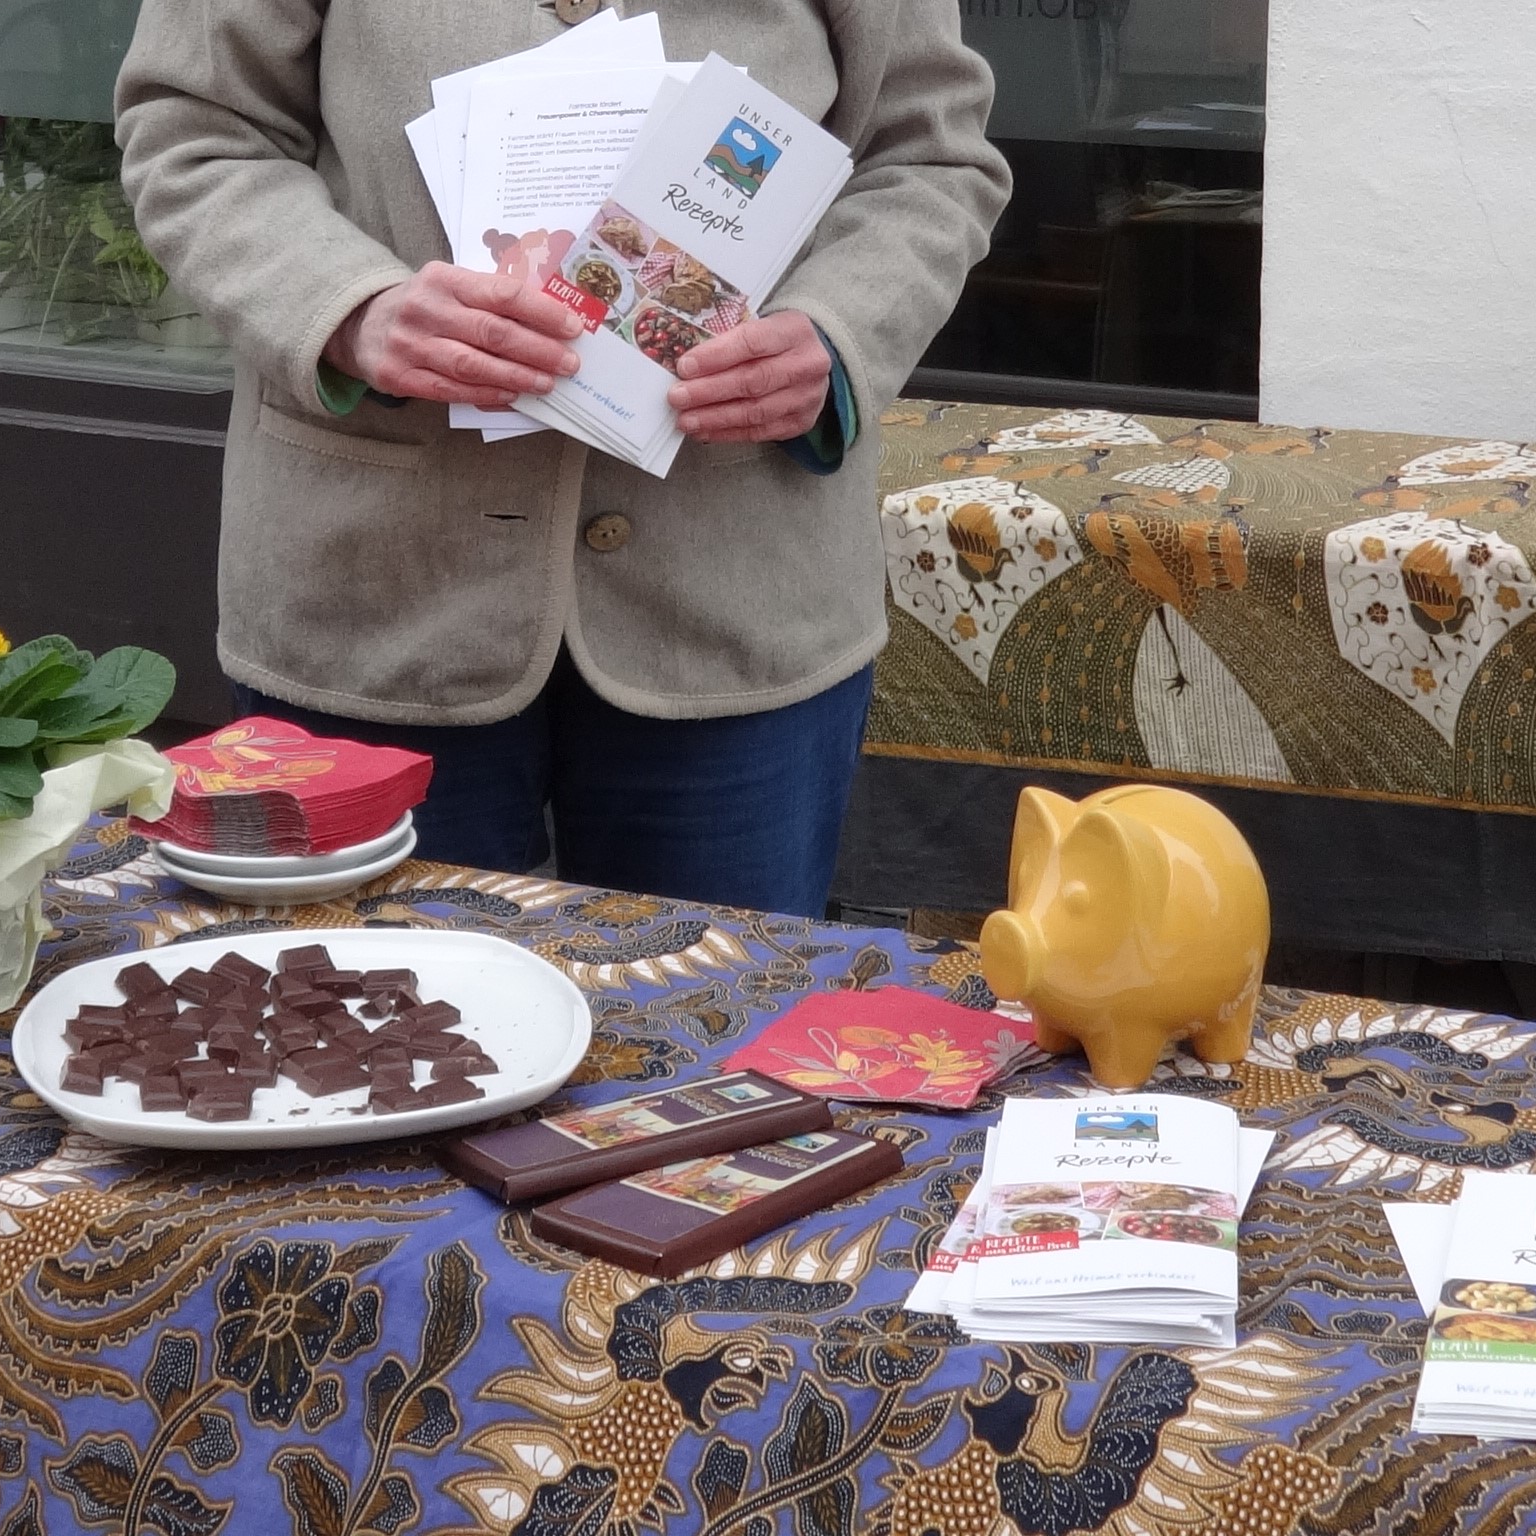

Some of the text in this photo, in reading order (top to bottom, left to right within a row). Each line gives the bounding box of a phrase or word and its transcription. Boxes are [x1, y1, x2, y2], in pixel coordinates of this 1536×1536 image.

[568, 101, 598, 110] Fairtrade
[536, 110, 581, 120] Frauenpower
[738, 102, 793, 147] UNSER
[693, 166, 748, 211] LAND
[661, 182, 745, 241] Rezepte
[547, 277, 585, 308] REZEPTE
[1077, 1104, 1160, 1113] UNSER
[1073, 1141, 1159, 1150] LAND
[1054, 1151, 1182, 1169] Rezepte
[985, 1235, 1040, 1249] REZEPTE
[1430, 1341, 1489, 1353] REZEPTE
